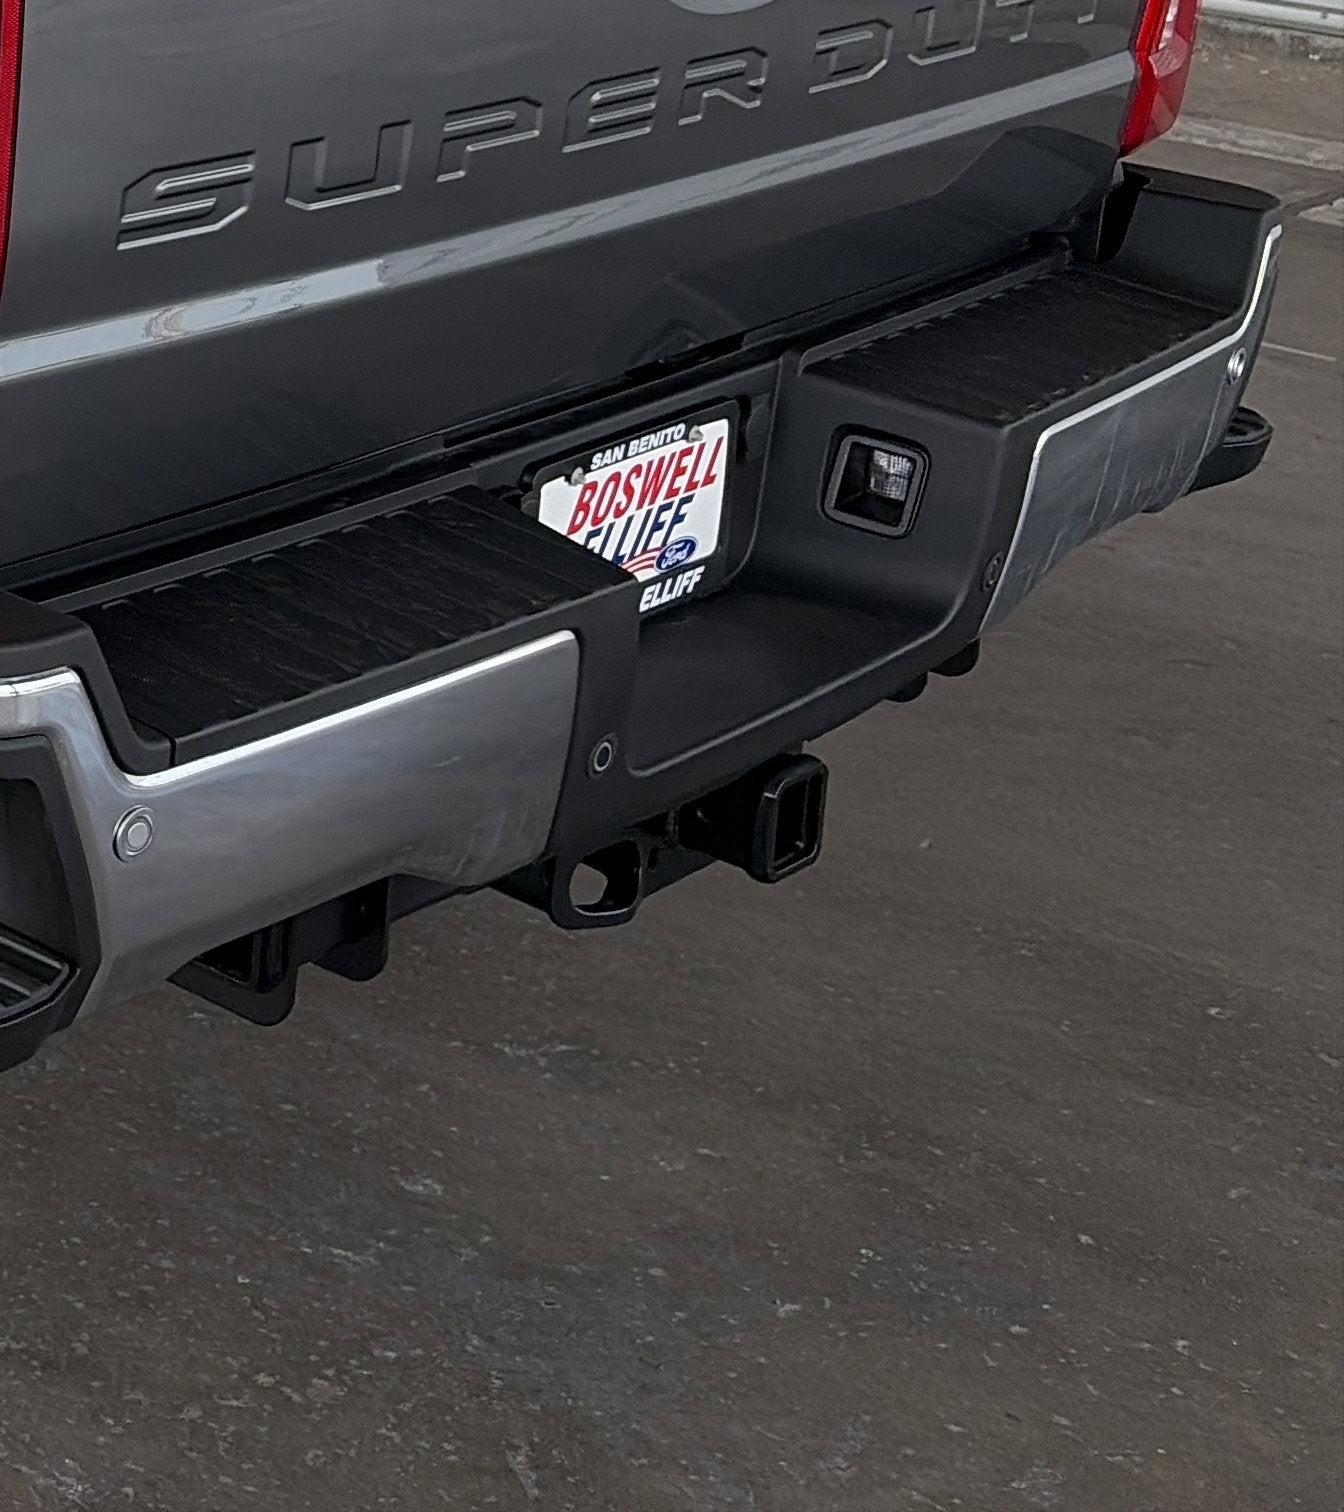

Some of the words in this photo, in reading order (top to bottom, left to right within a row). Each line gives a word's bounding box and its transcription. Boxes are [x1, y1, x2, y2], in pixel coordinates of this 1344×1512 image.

[117, 47, 769, 251] SUPER
[590, 445, 625, 471] SAN
[628, 423, 686, 454] BENITO
[567, 436, 725, 536] BOSWELL
[639, 565, 706, 613] ELLIFF
